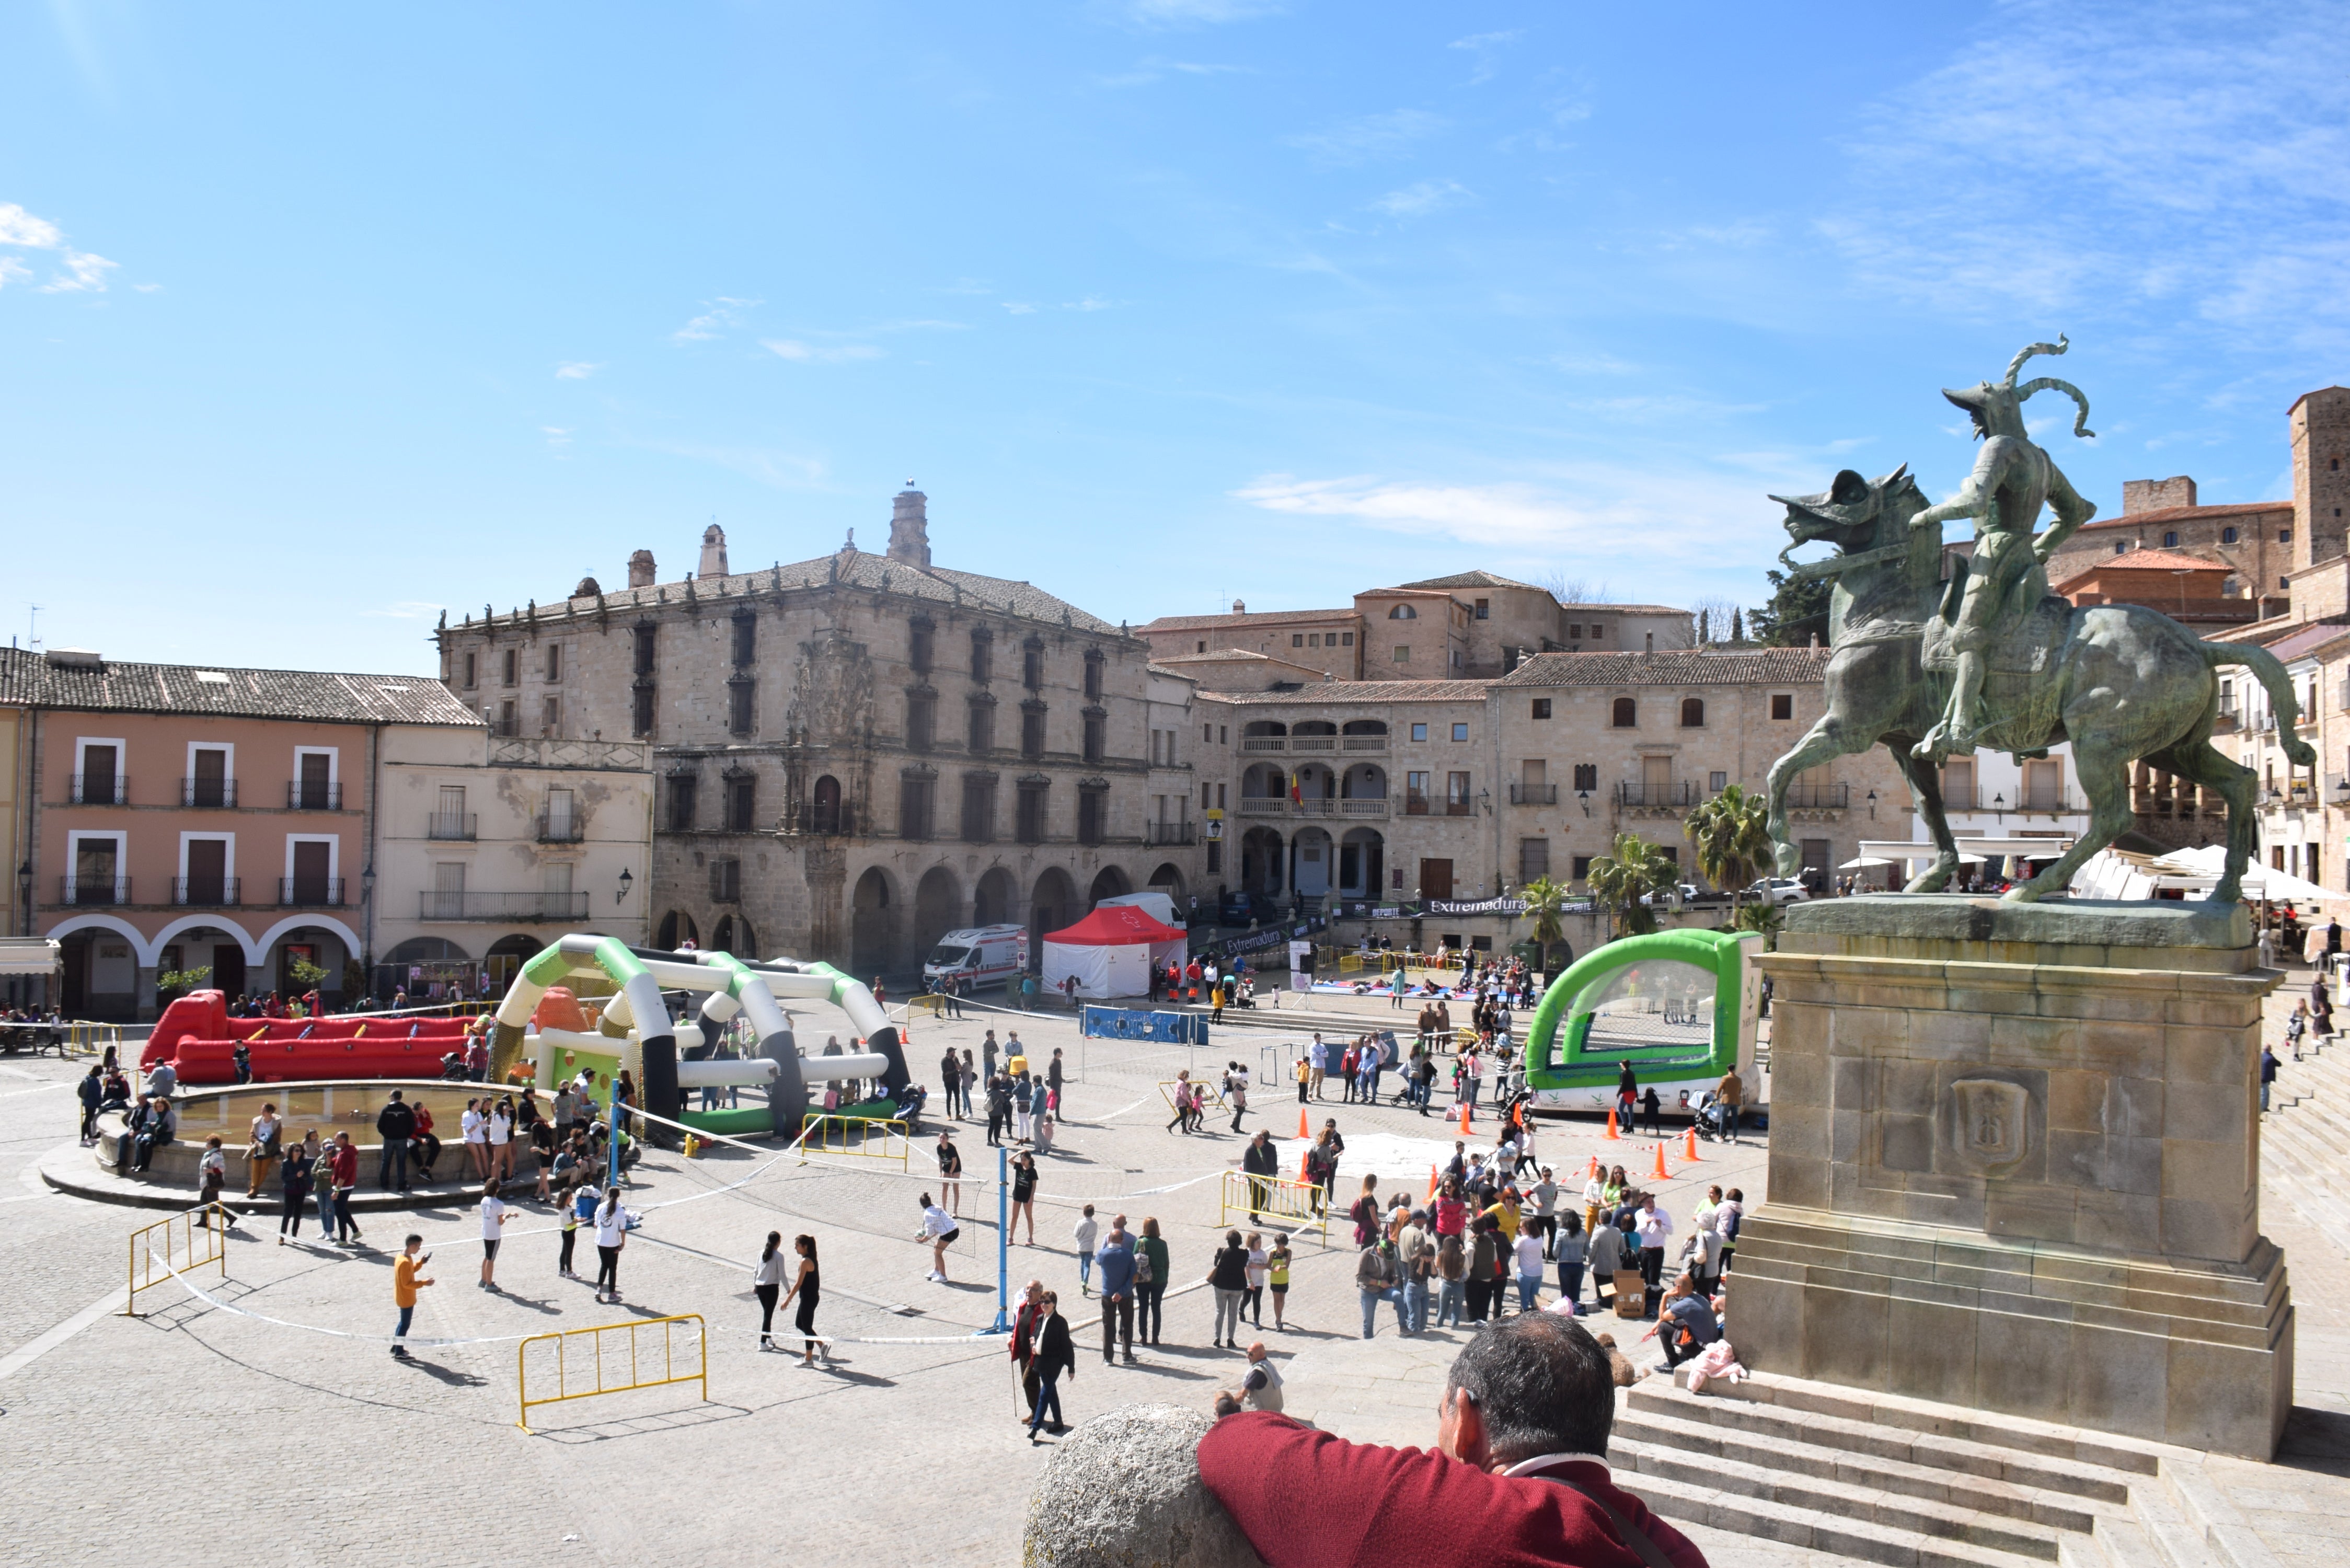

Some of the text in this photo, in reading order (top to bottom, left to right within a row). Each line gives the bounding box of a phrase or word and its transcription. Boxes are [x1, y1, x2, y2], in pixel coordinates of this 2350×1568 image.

[1372, 907, 1400, 916] DEPORTE
[1431, 897, 1527, 913] Extremadura
[1227, 930, 1280, 953] Extremadura
